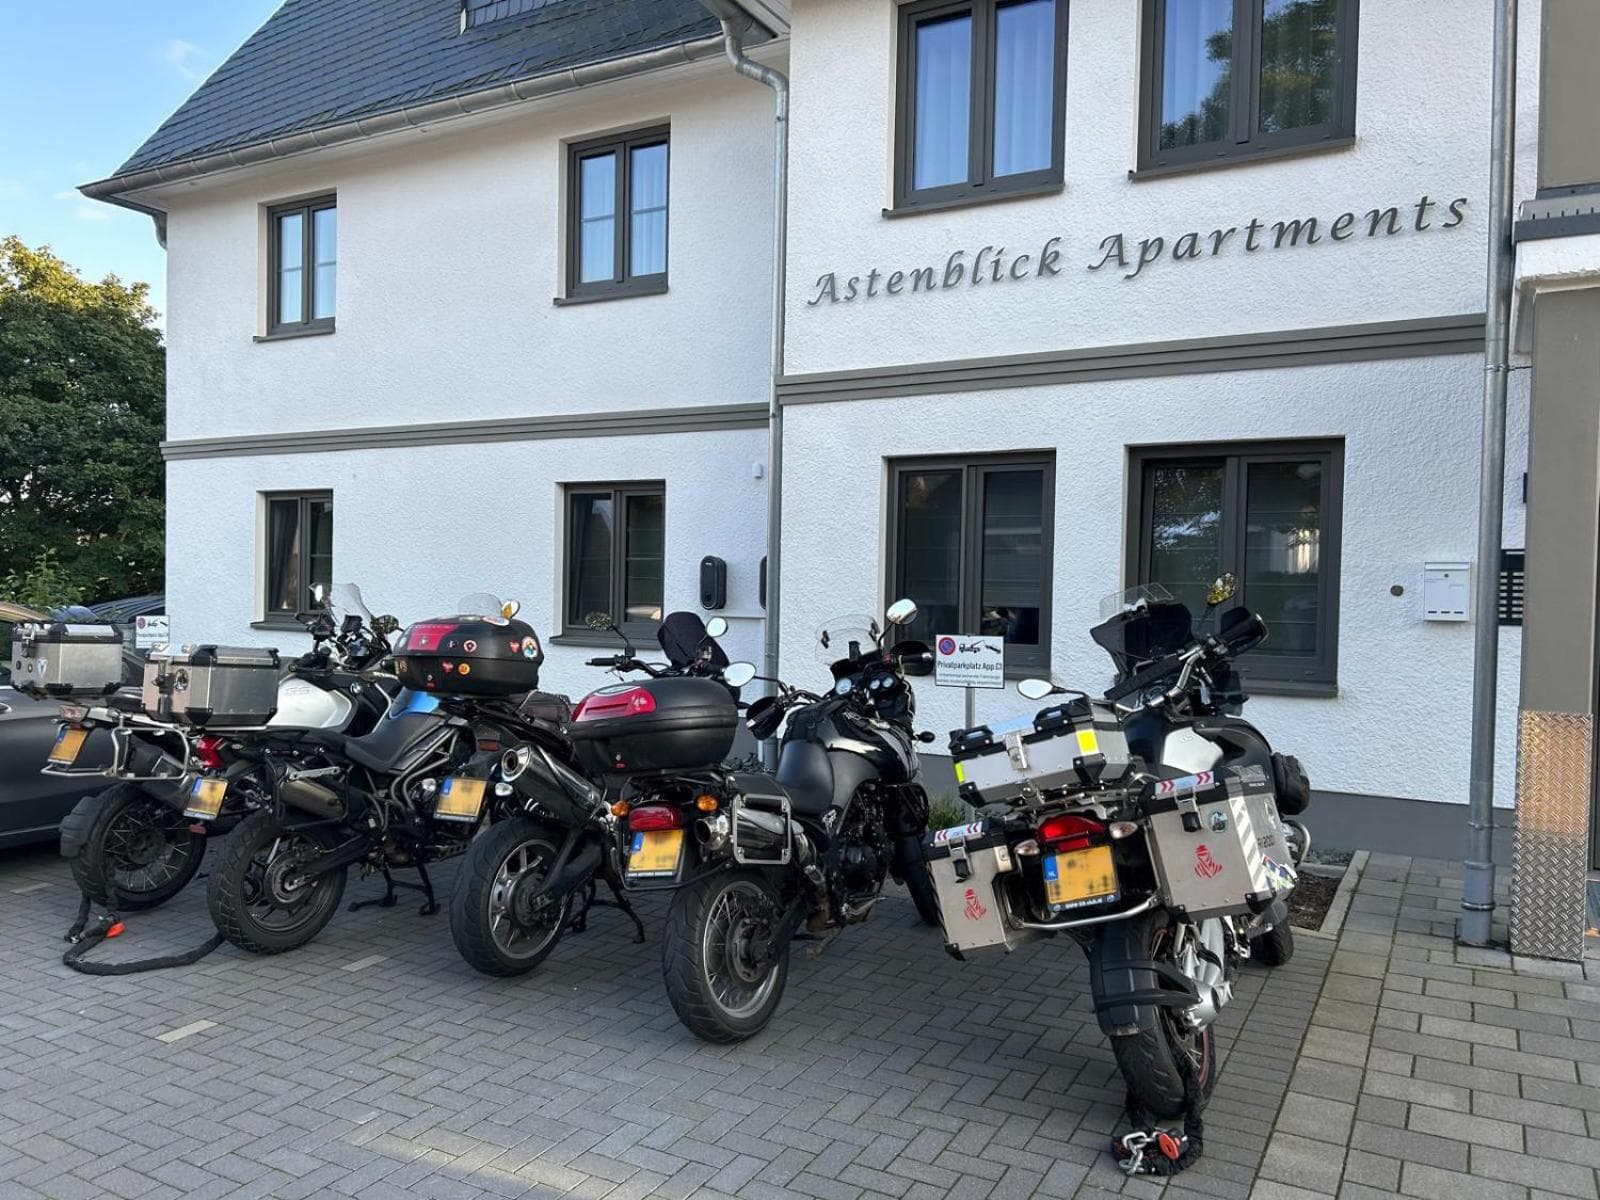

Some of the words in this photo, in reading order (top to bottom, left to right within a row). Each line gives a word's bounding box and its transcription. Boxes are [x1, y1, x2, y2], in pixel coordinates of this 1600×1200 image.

[807, 236, 1063, 305] Astenblick
[1087, 195, 1468, 280] Apartments
[938, 660, 981, 671] Privatparkplatz
